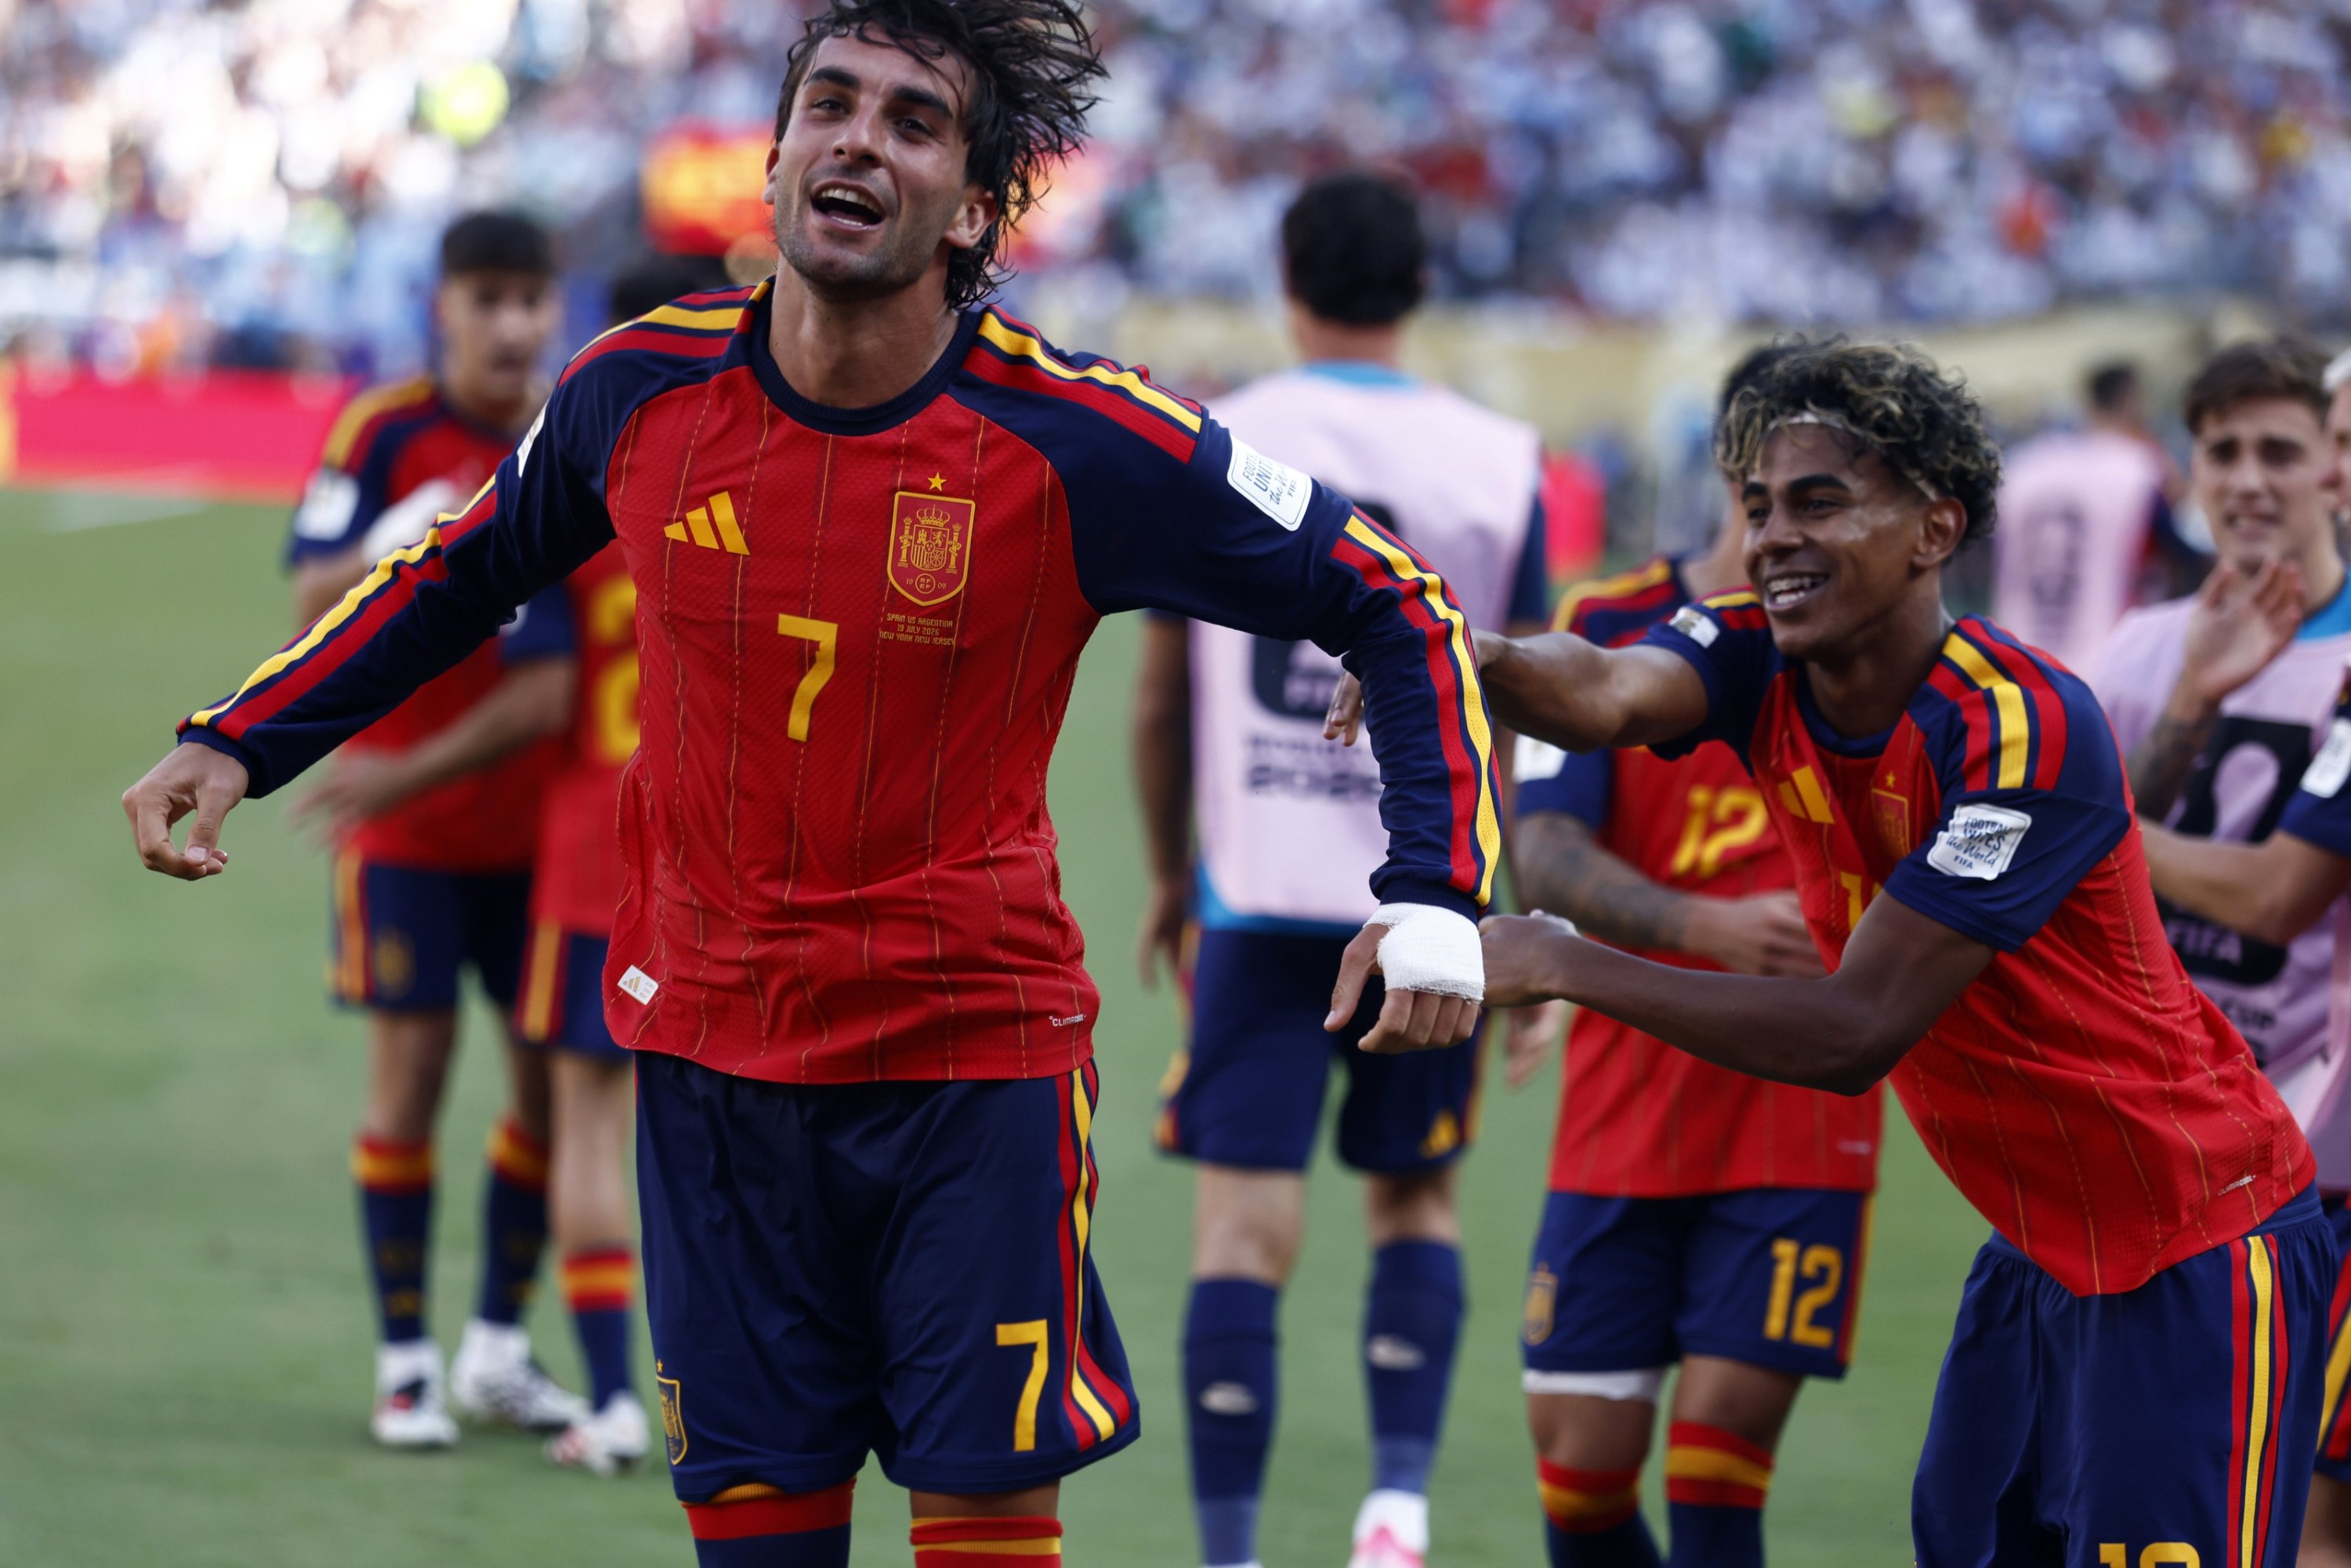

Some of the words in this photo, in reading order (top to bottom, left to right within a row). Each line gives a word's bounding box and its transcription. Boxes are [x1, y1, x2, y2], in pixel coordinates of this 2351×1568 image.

[879, 631, 894, 639] NEW
[896, 632, 913, 642] YORK
[915, 635, 930, 644] NEW
[933, 637, 955, 646] JERSEY
[887, 613, 906, 622] SPAIN
[918, 617, 953, 627] ARGENTINA
[897, 623, 904, 632] 19
[906, 625, 921, 634] JULY
[922, 627, 940, 636] 2026
[777, 613, 839, 742] 7
[1672, 784, 1767, 878] 12
[1954, 855, 1973, 868] FIFA
[1763, 1238, 1842, 1349] 12
[996, 1319, 1049, 1452] 7
